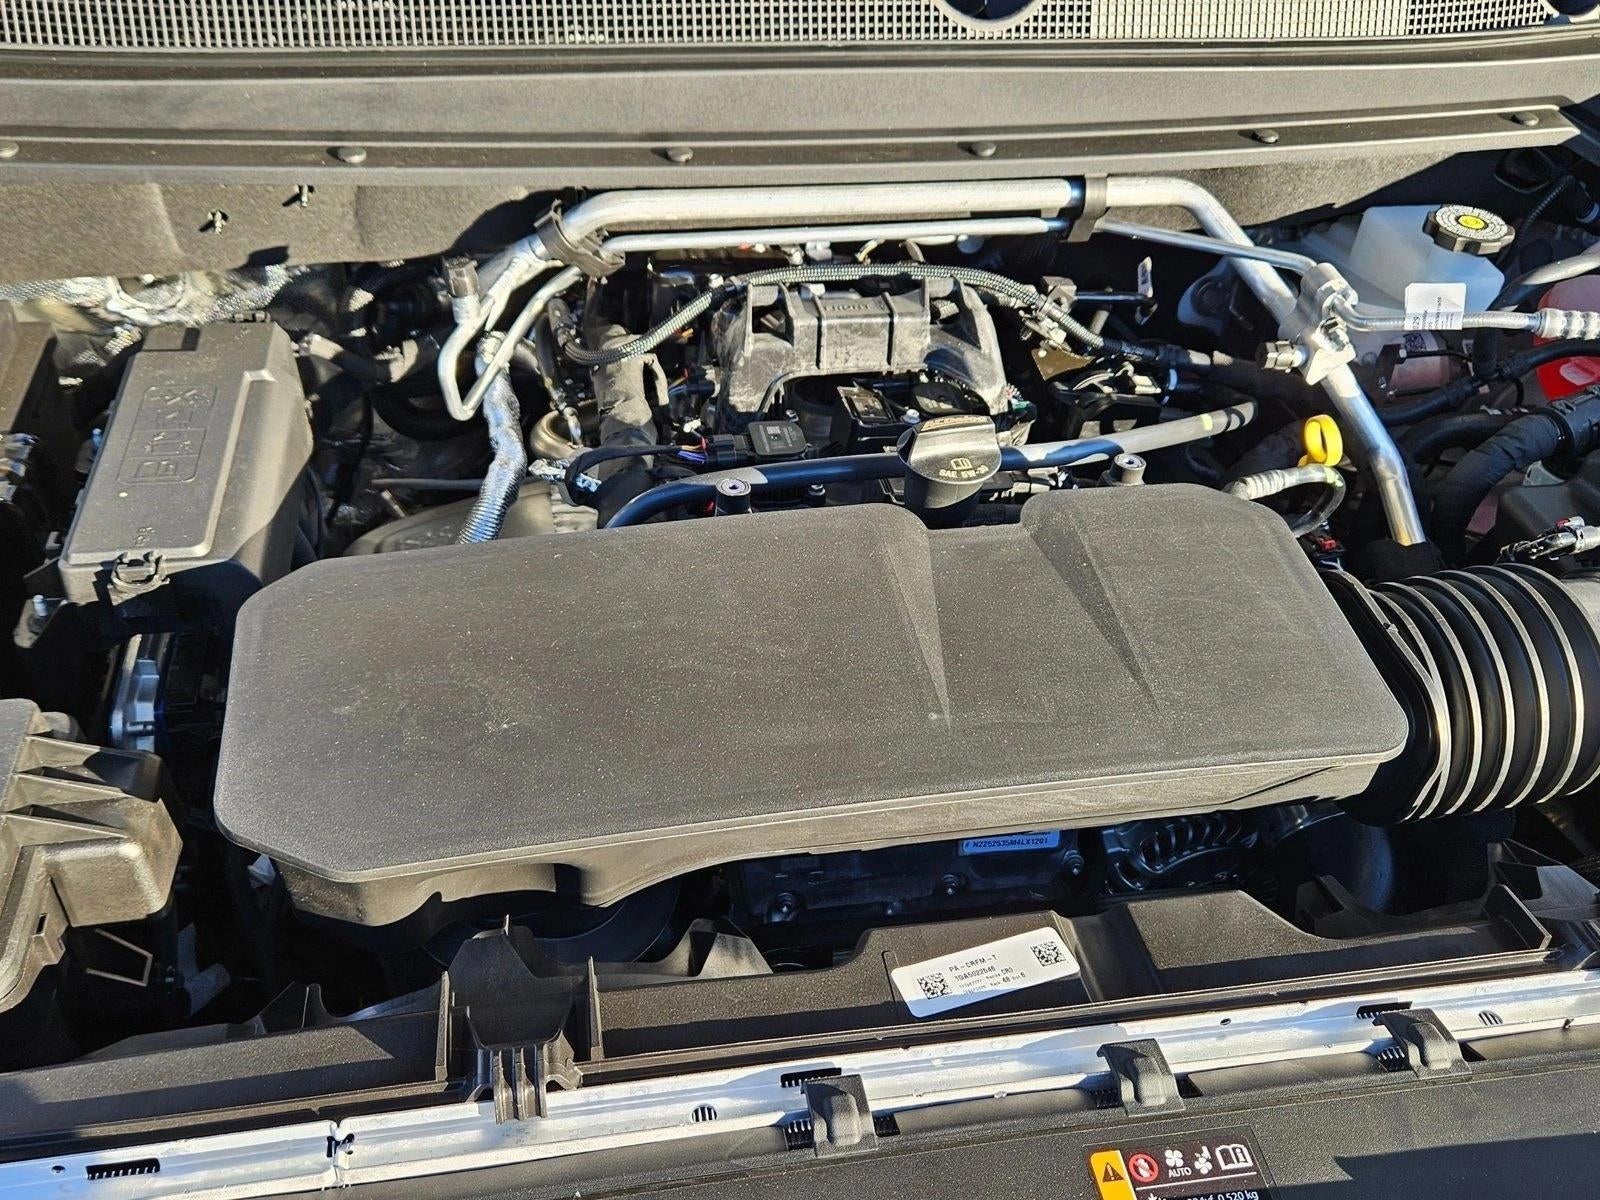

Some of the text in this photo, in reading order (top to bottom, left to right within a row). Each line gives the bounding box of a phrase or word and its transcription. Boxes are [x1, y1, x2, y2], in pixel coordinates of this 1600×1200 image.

[939, 469, 957, 477] SAE
[1168, 1166, 1192, 1178] AUTO
[1244, 1189, 1259, 1200] kg
